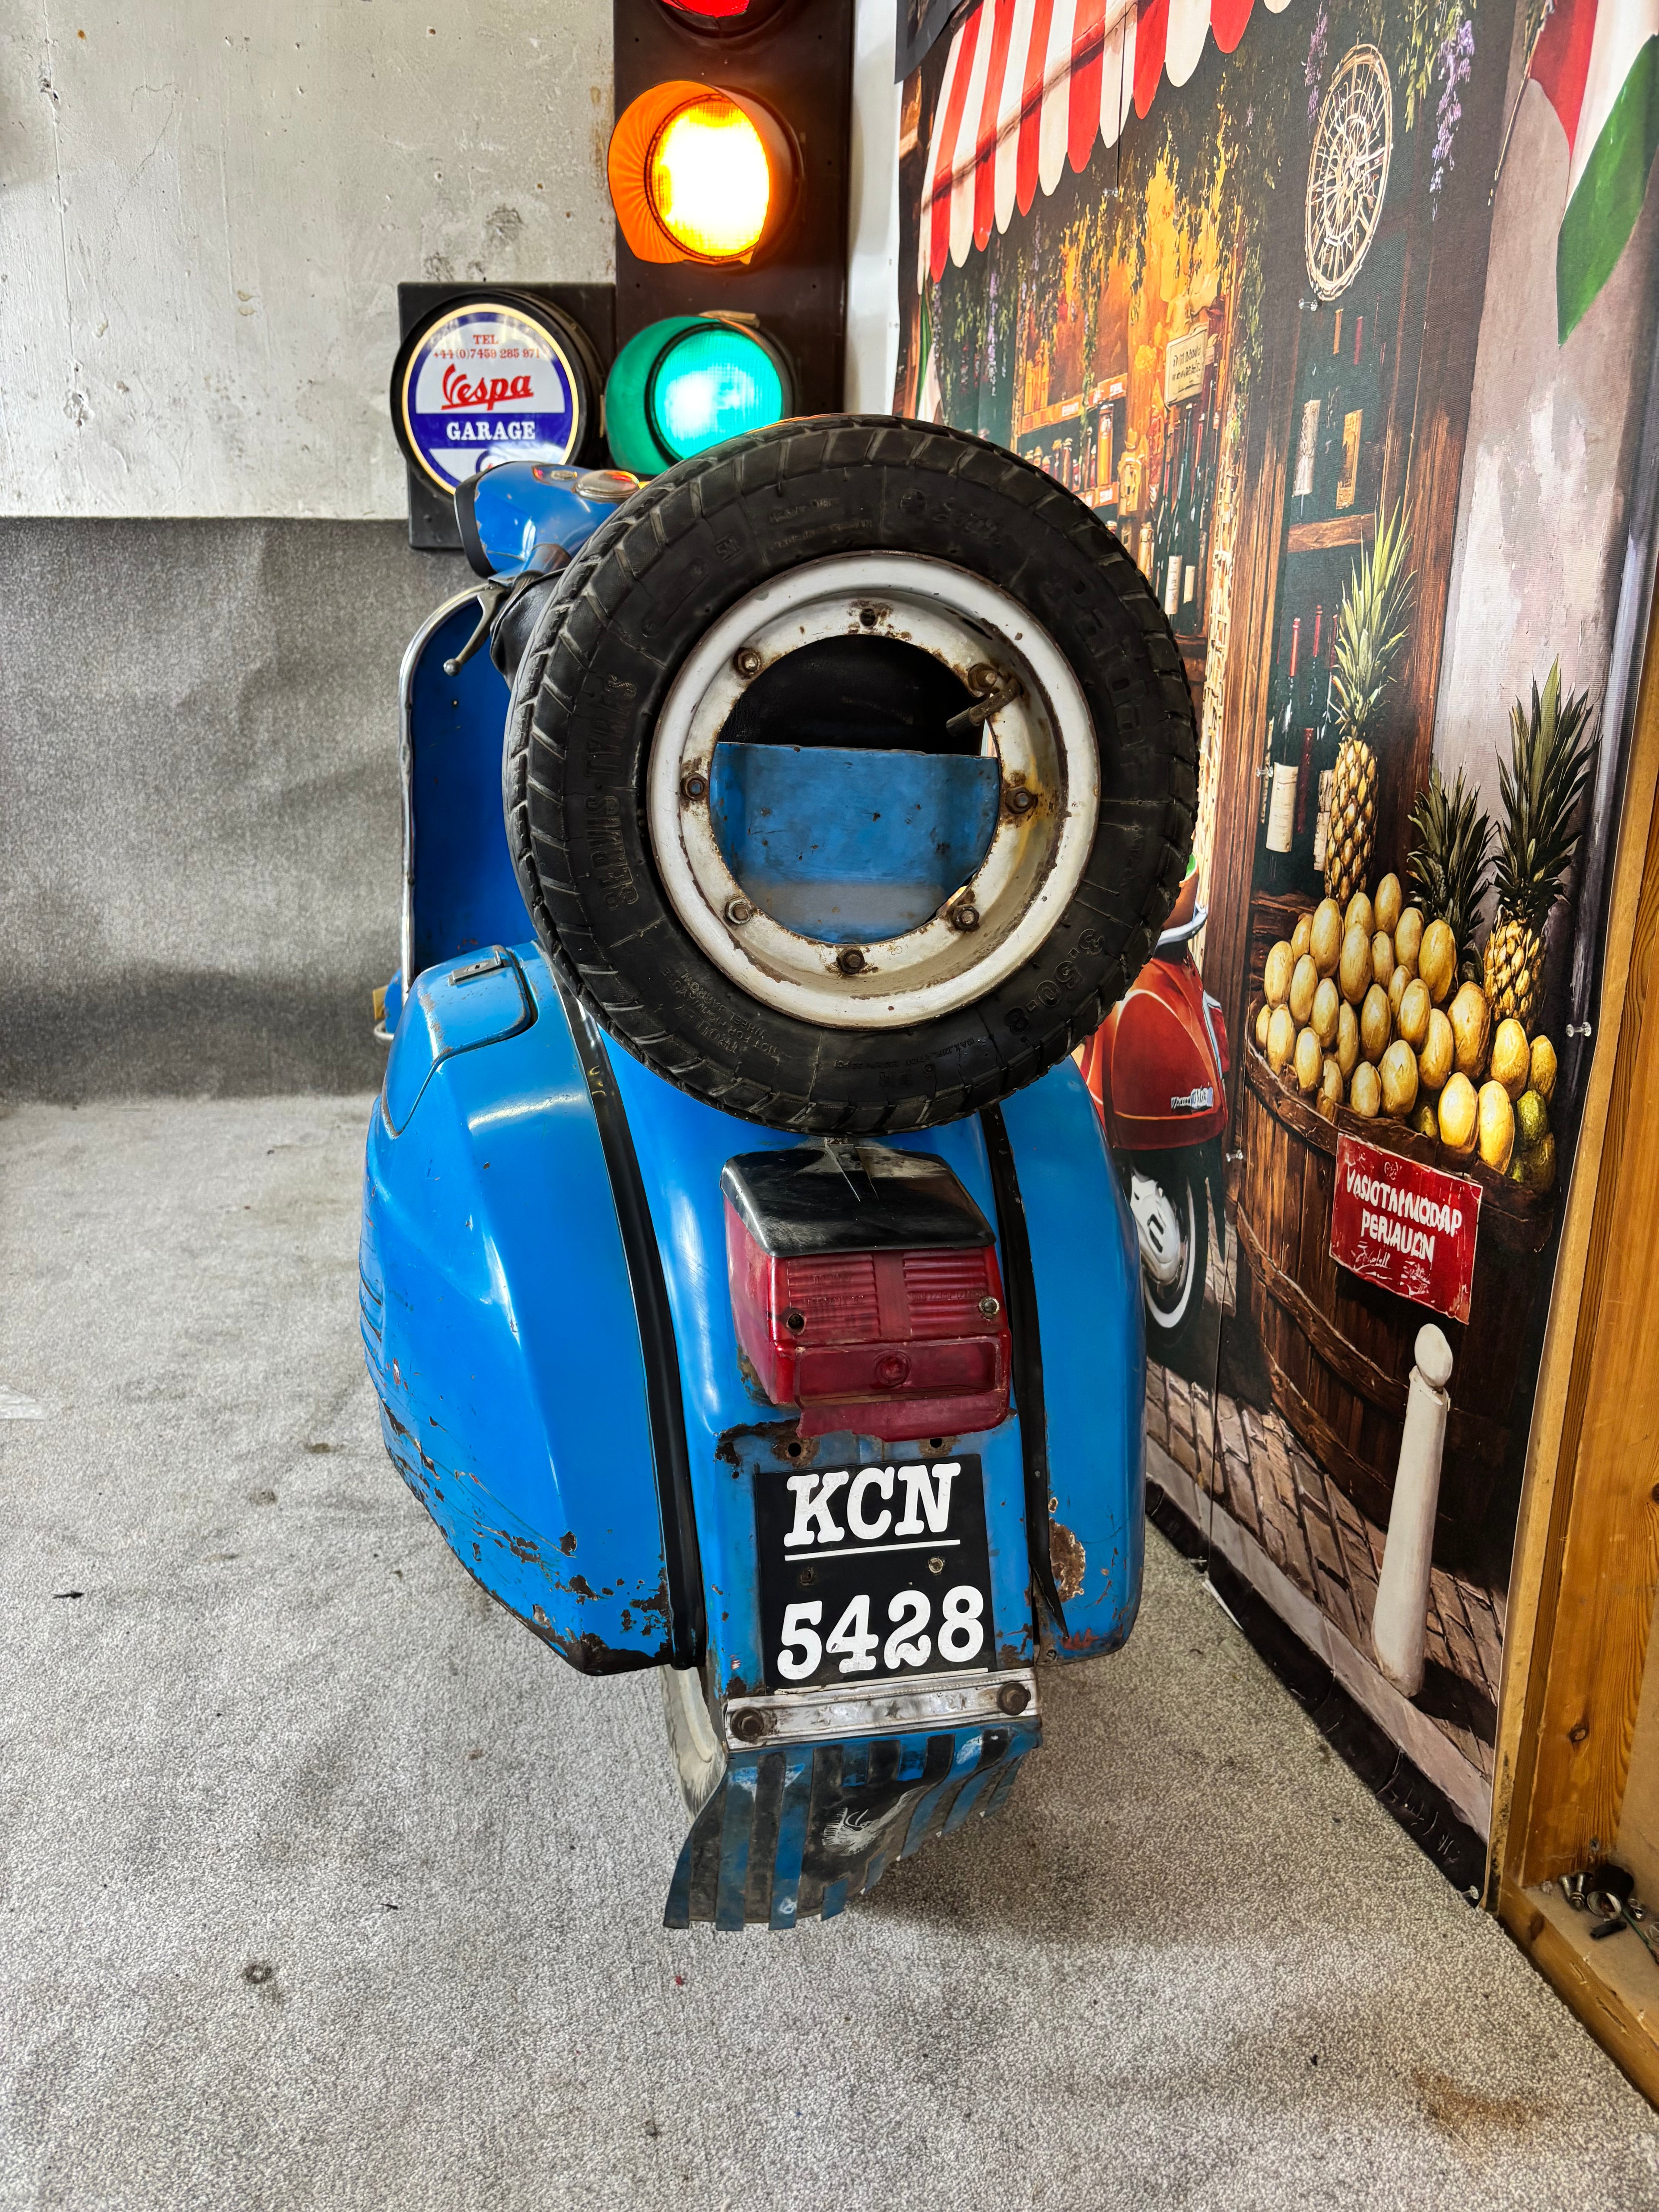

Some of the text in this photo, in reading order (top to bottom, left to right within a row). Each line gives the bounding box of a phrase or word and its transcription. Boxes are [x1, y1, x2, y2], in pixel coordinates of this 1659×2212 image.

[473, 334, 499, 344] TEL
[500, 349, 519, 359] 285
[441, 363, 534, 411] Vespa
[446, 421, 536, 441] GARAGE
[584, 795, 639, 911] SERVIS
[1004, 928, 1106, 1035] 3.50-8
[783, 1462, 961, 1547] KCN
[777, 1585, 984, 1680] 5428
